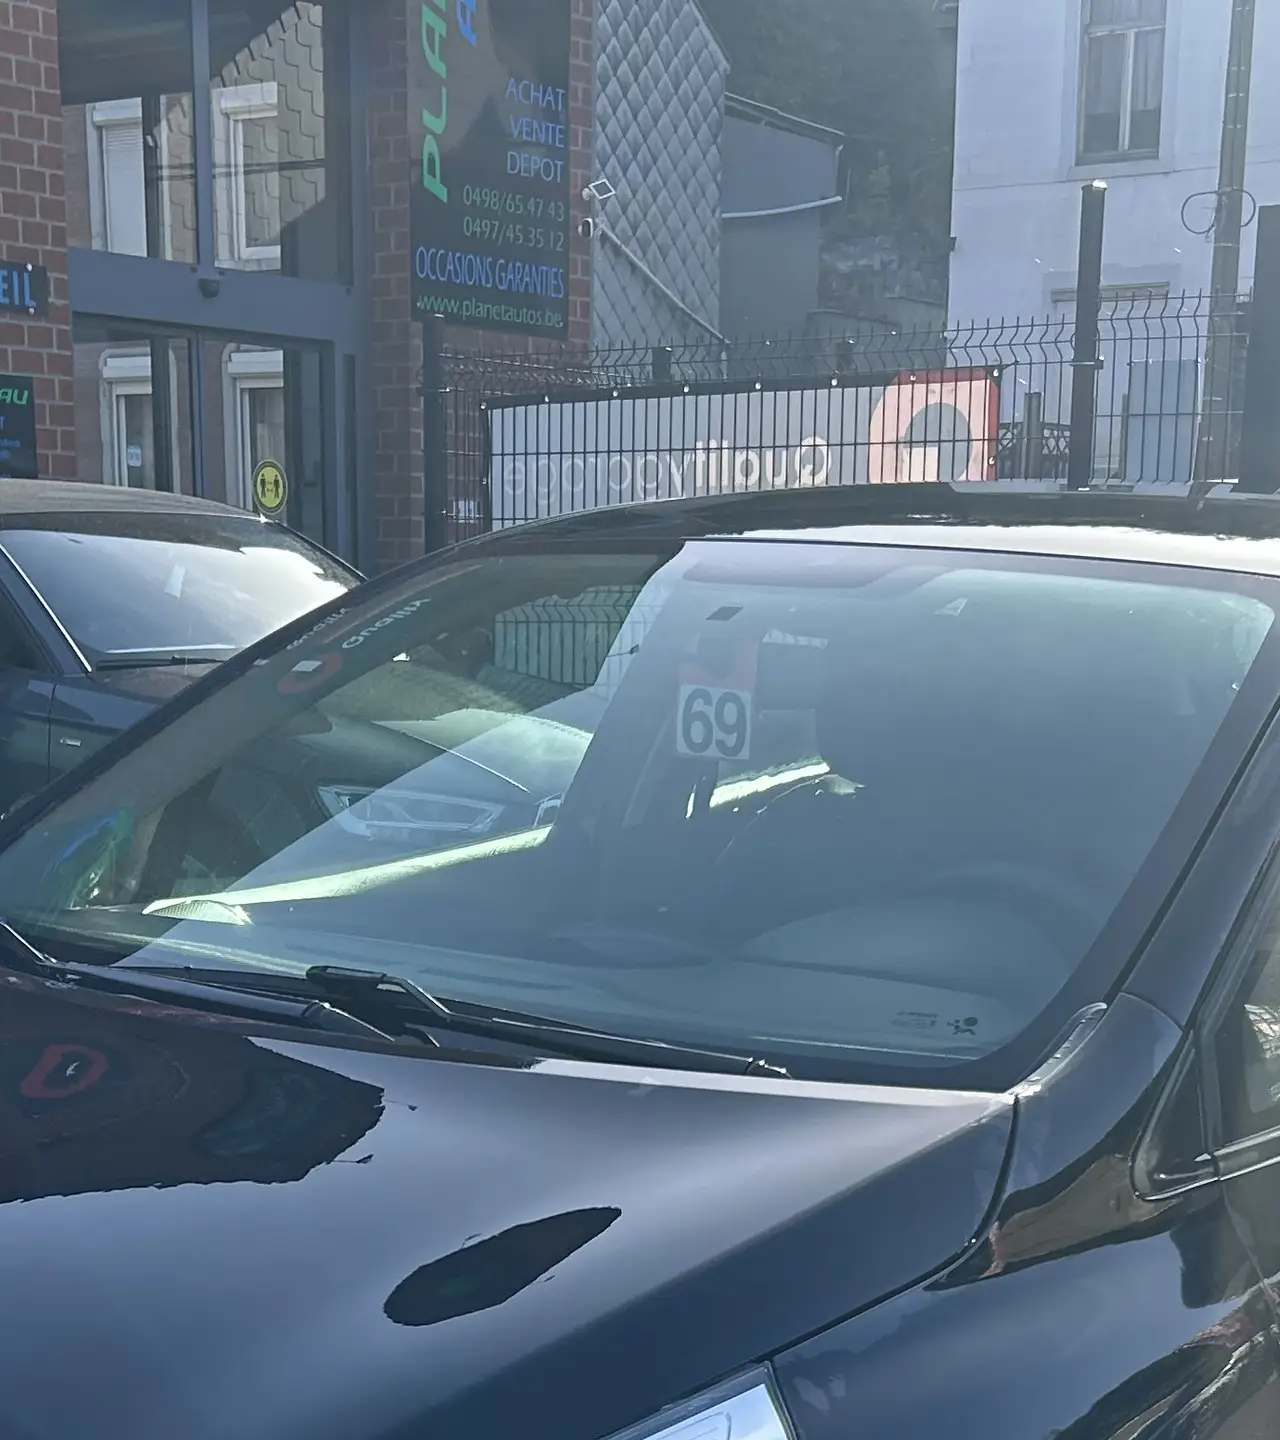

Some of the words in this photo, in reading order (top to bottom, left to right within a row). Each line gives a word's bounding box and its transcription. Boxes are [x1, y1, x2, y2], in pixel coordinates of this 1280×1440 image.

[422, 0, 448, 204] PLA
[505, 78, 565, 112] ACHAT
[510, 114, 565, 148] VENTE
[507, 151, 565, 183] DEPOT
[415, 246, 493, 288] OCCASIONS
[495, 258, 565, 298] GARANTIES
[419, 294, 564, 328] www.planetautos.be
[680, 687, 749, 758] 69
